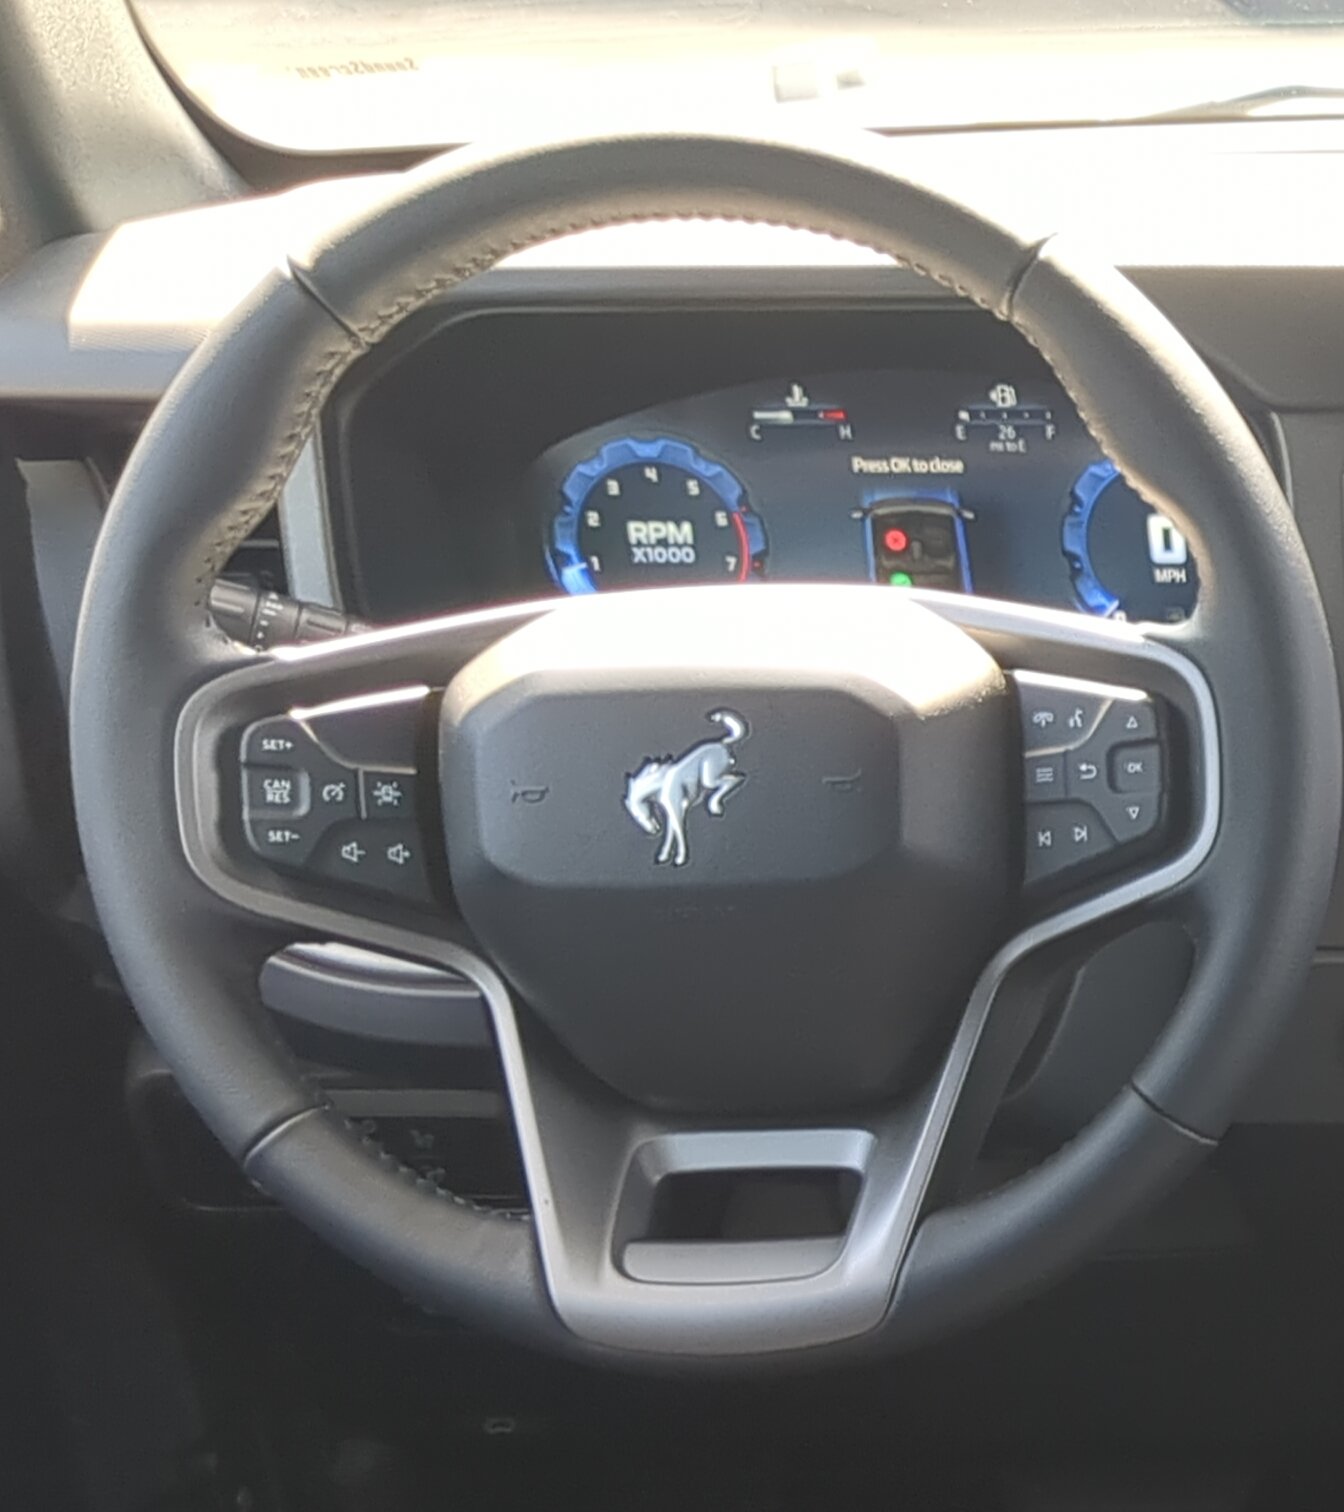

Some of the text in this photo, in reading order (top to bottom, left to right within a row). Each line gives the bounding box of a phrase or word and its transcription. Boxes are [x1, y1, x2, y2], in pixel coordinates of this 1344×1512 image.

[750, 425, 761, 439] C
[840, 425, 852, 439] H
[955, 426, 966, 440] E
[998, 425, 1016, 439] 26
[852, 457, 964, 473] Press OK to close
[644, 466, 658, 482] 4
[606, 479, 620, 496] 3
[686, 479, 700, 496] 5
[586, 510, 600, 527] 2
[715, 511, 728, 527] 6
[626, 520, 694, 545] RPM
[631, 547, 696, 563] X1000
[590, 556, 600, 571] 1
[725, 556, 737, 571] 7
[1153, 567, 1187, 583] MPH
[262, 739, 294, 751] SET+
[1126, 762, 1143, 774] OK
[263, 779, 291, 791] CAN
[265, 791, 291, 804] RES
